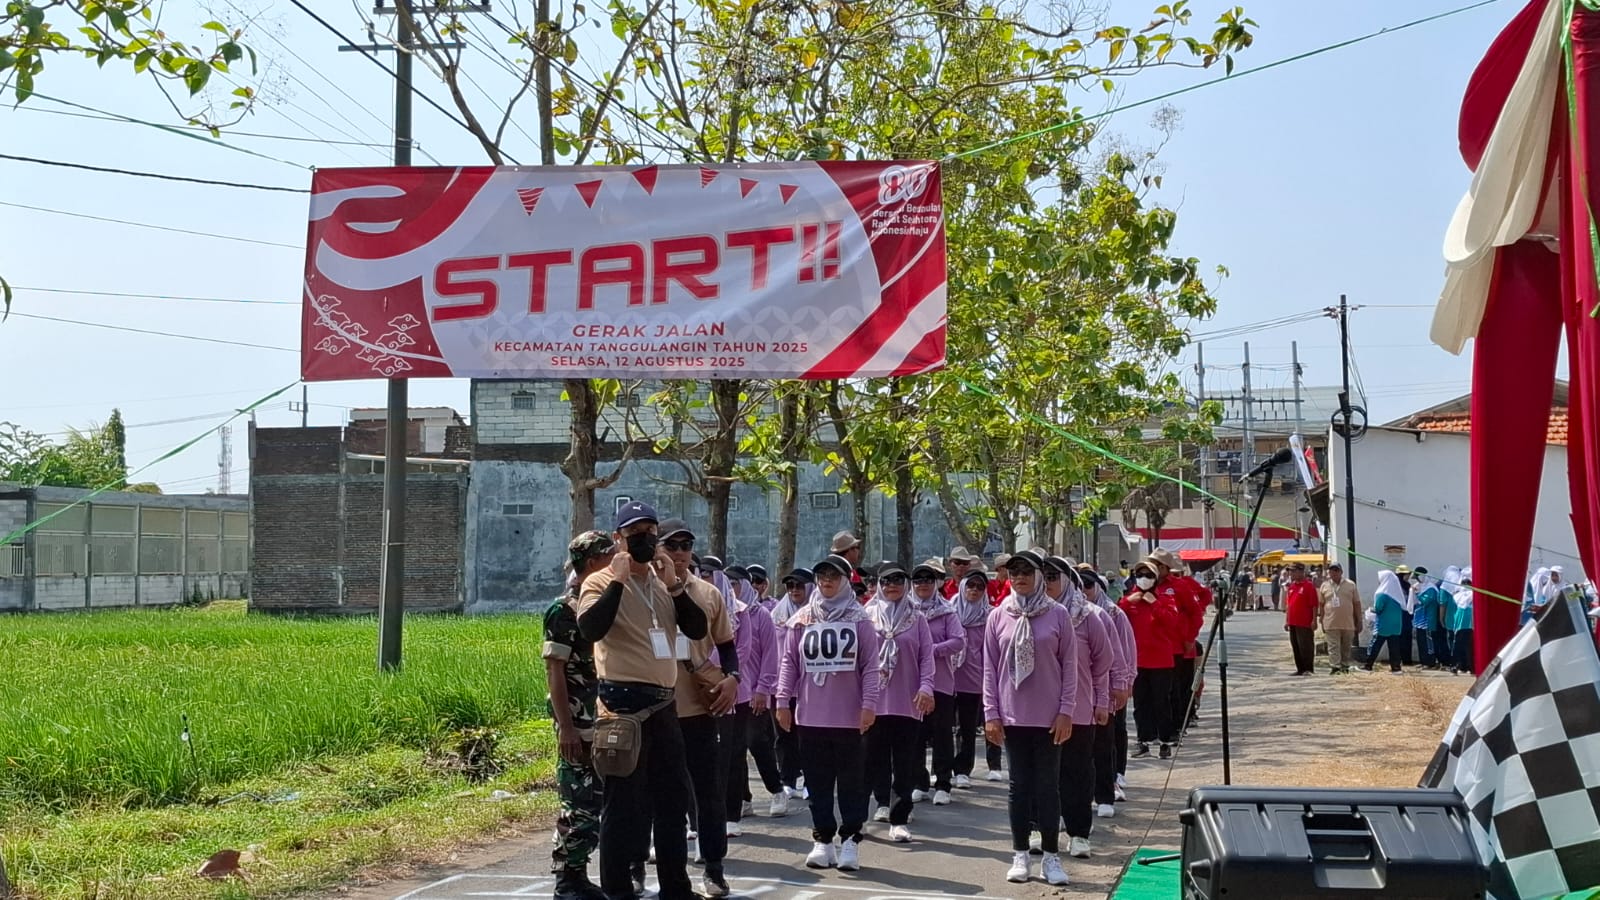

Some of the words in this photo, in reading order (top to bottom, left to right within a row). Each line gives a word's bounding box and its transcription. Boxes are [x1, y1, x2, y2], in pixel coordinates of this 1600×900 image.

[871, 214, 901, 228] Rakat
[432, 219, 844, 323] START!!
[572, 324, 648, 338] GERAK
[653, 321, 726, 338] JALAN
[494, 341, 584, 353] KECAMATAN
[590, 342, 708, 353] TANGGULANGIN
[713, 342, 766, 353] TAHUN
[772, 342, 809, 353] 2025
[551, 356, 610, 368] SELASA,
[615, 356, 630, 367] 12
[634, 356, 705, 367] AGUSTUS
[710, 356, 746, 367] 2025
[803, 627, 856, 660] 002
